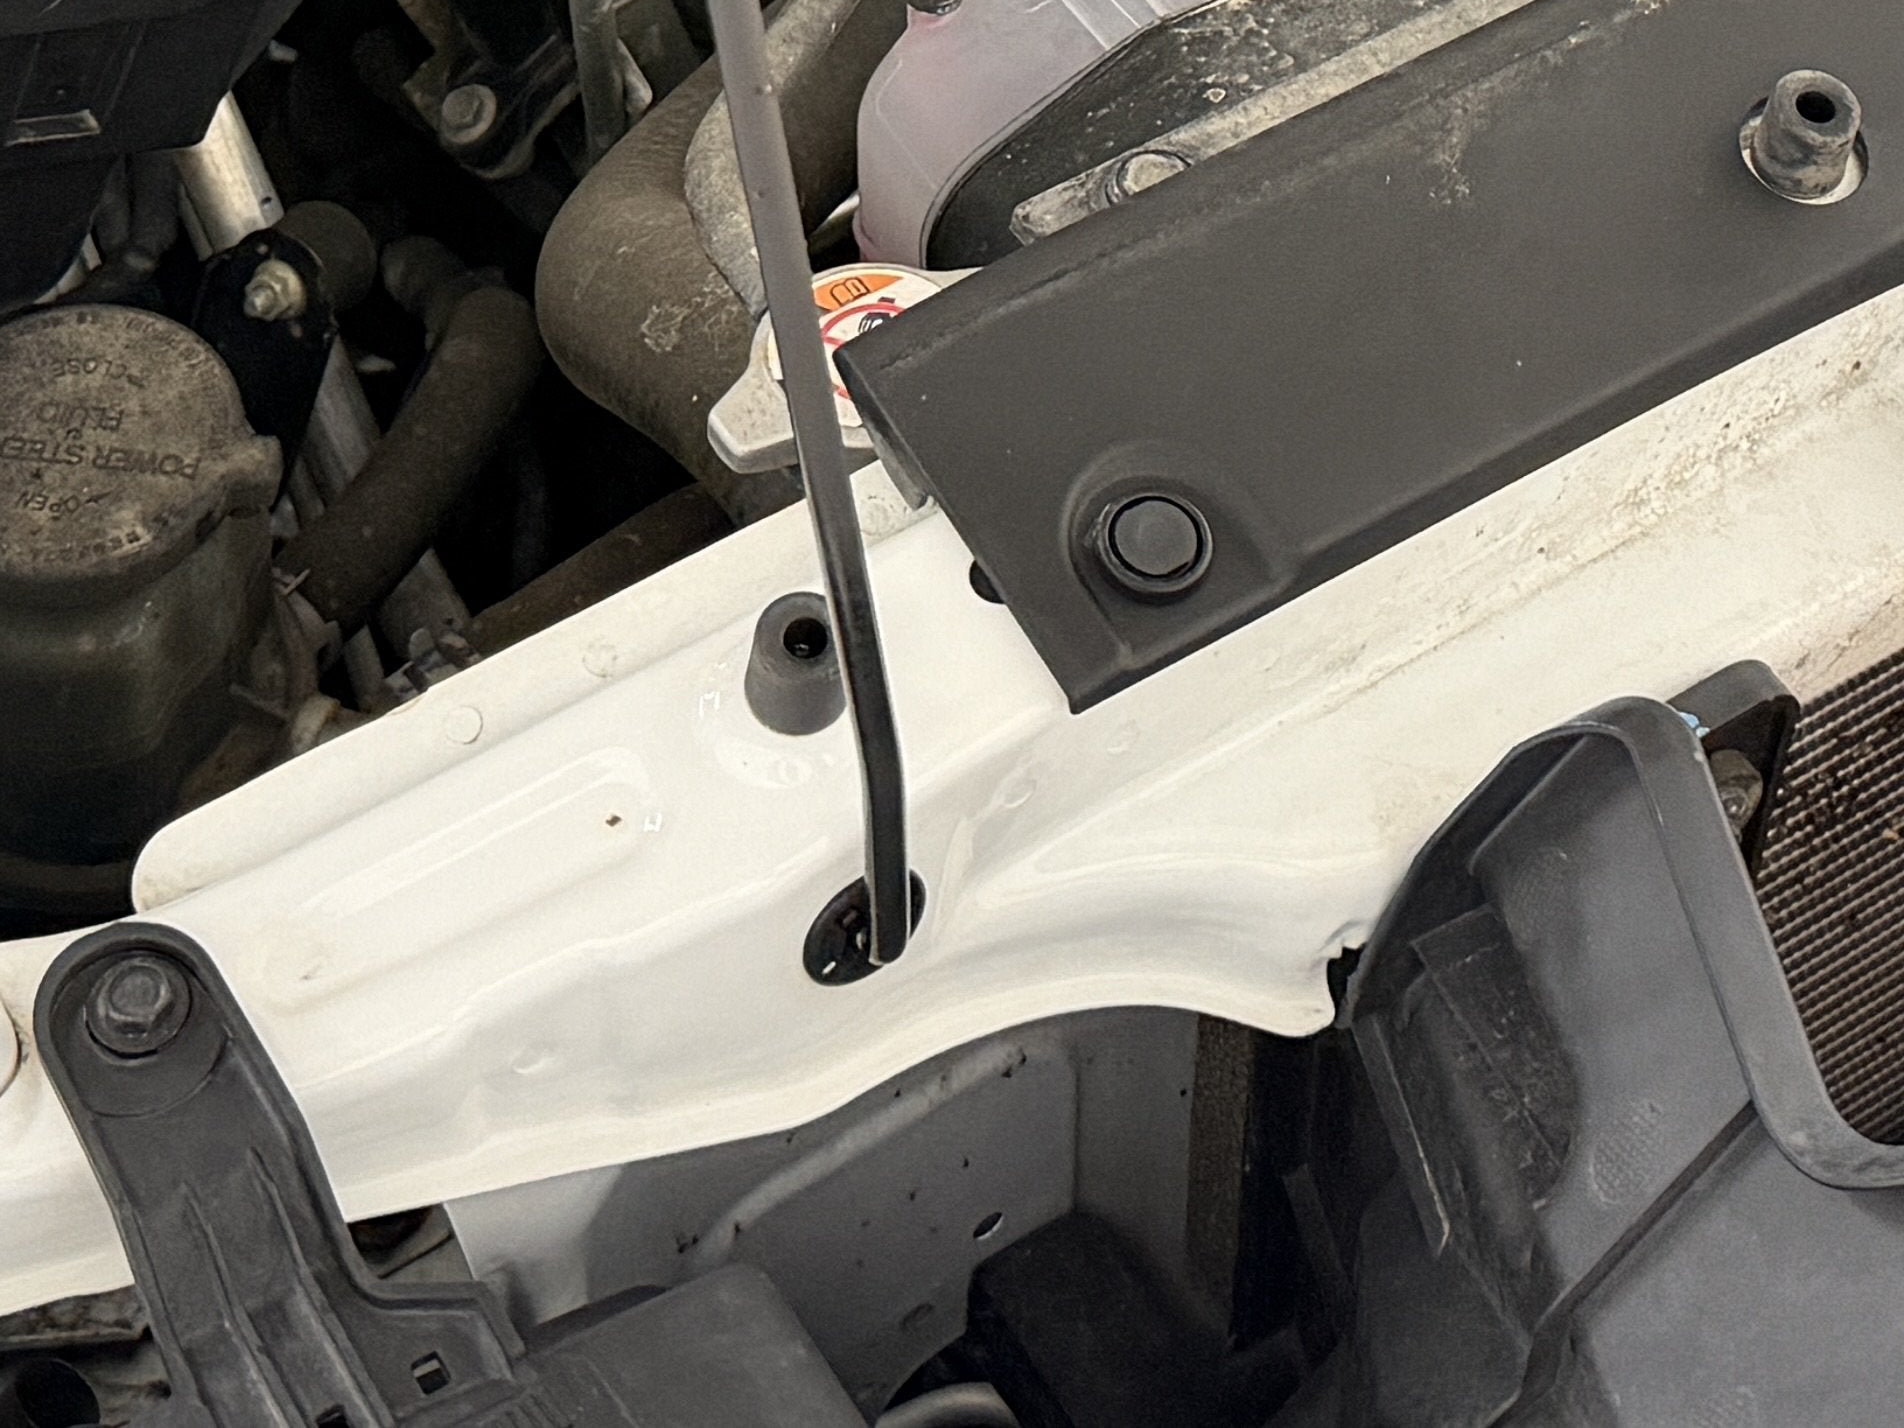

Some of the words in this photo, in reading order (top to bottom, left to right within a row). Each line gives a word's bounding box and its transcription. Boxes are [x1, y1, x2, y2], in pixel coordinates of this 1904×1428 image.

[50, 356, 128, 381] CLOSE
[34, 400, 126, 433] FLUID
[92, 450, 199, 480] POWER
[16, 490, 82, 516] OPEN
